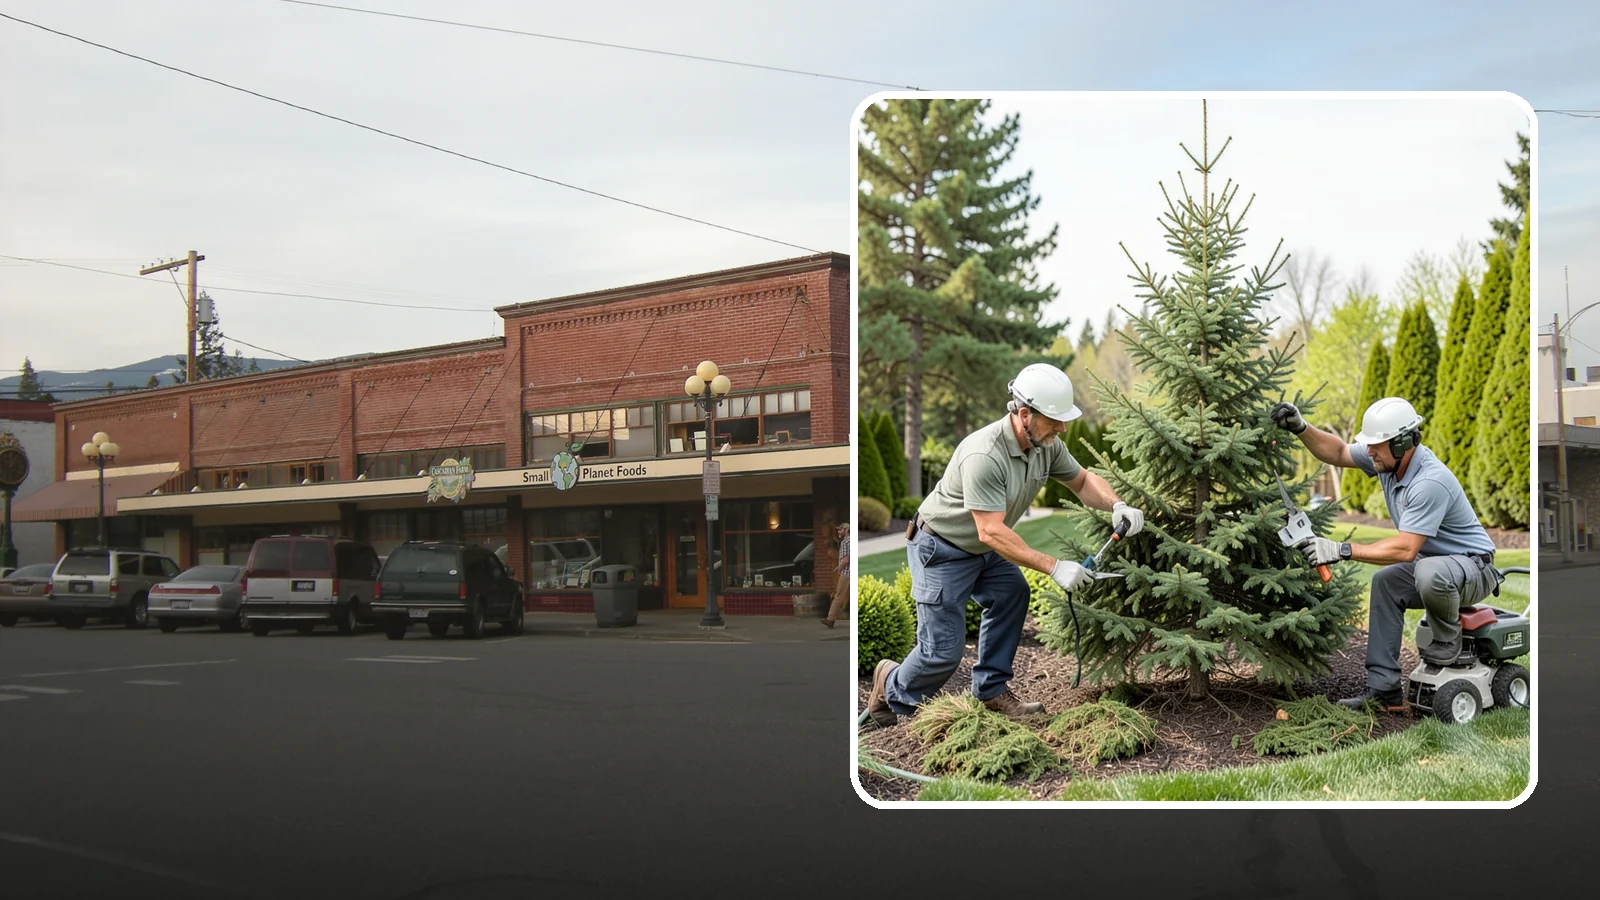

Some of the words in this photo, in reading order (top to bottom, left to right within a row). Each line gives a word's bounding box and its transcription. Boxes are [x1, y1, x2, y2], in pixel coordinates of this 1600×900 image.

[431, 466, 455, 475] CASCADIAN
[523, 470, 549, 483] Small
[583, 468, 614, 480] Planet
[617, 464, 647, 477] Foods
